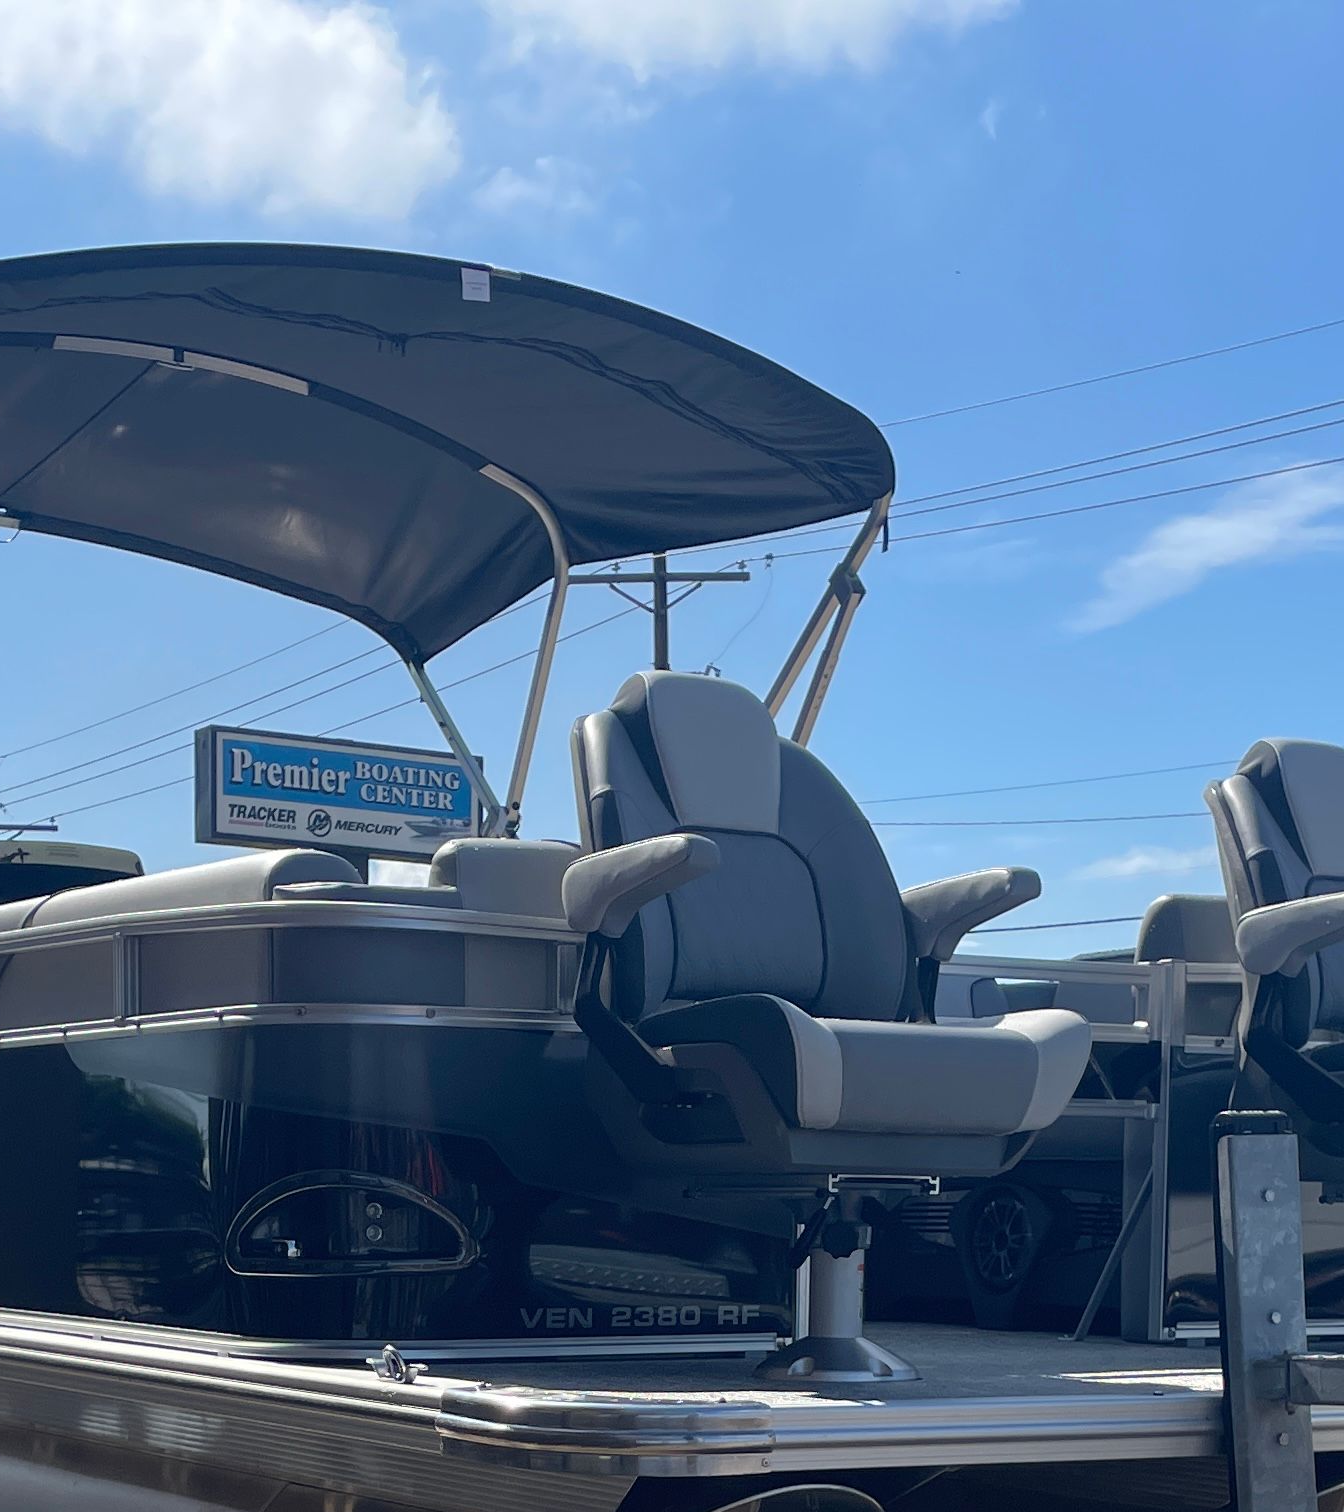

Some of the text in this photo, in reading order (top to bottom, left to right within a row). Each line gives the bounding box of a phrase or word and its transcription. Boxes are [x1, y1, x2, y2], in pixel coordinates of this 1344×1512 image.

[230, 747, 461, 795] Premier BOATING
[360, 783, 454, 811] CENTER
[228, 803, 297, 824] TRACKER
[334, 819, 402, 836] MERCURY
[519, 1304, 761, 1329] VEN 2380 RF
